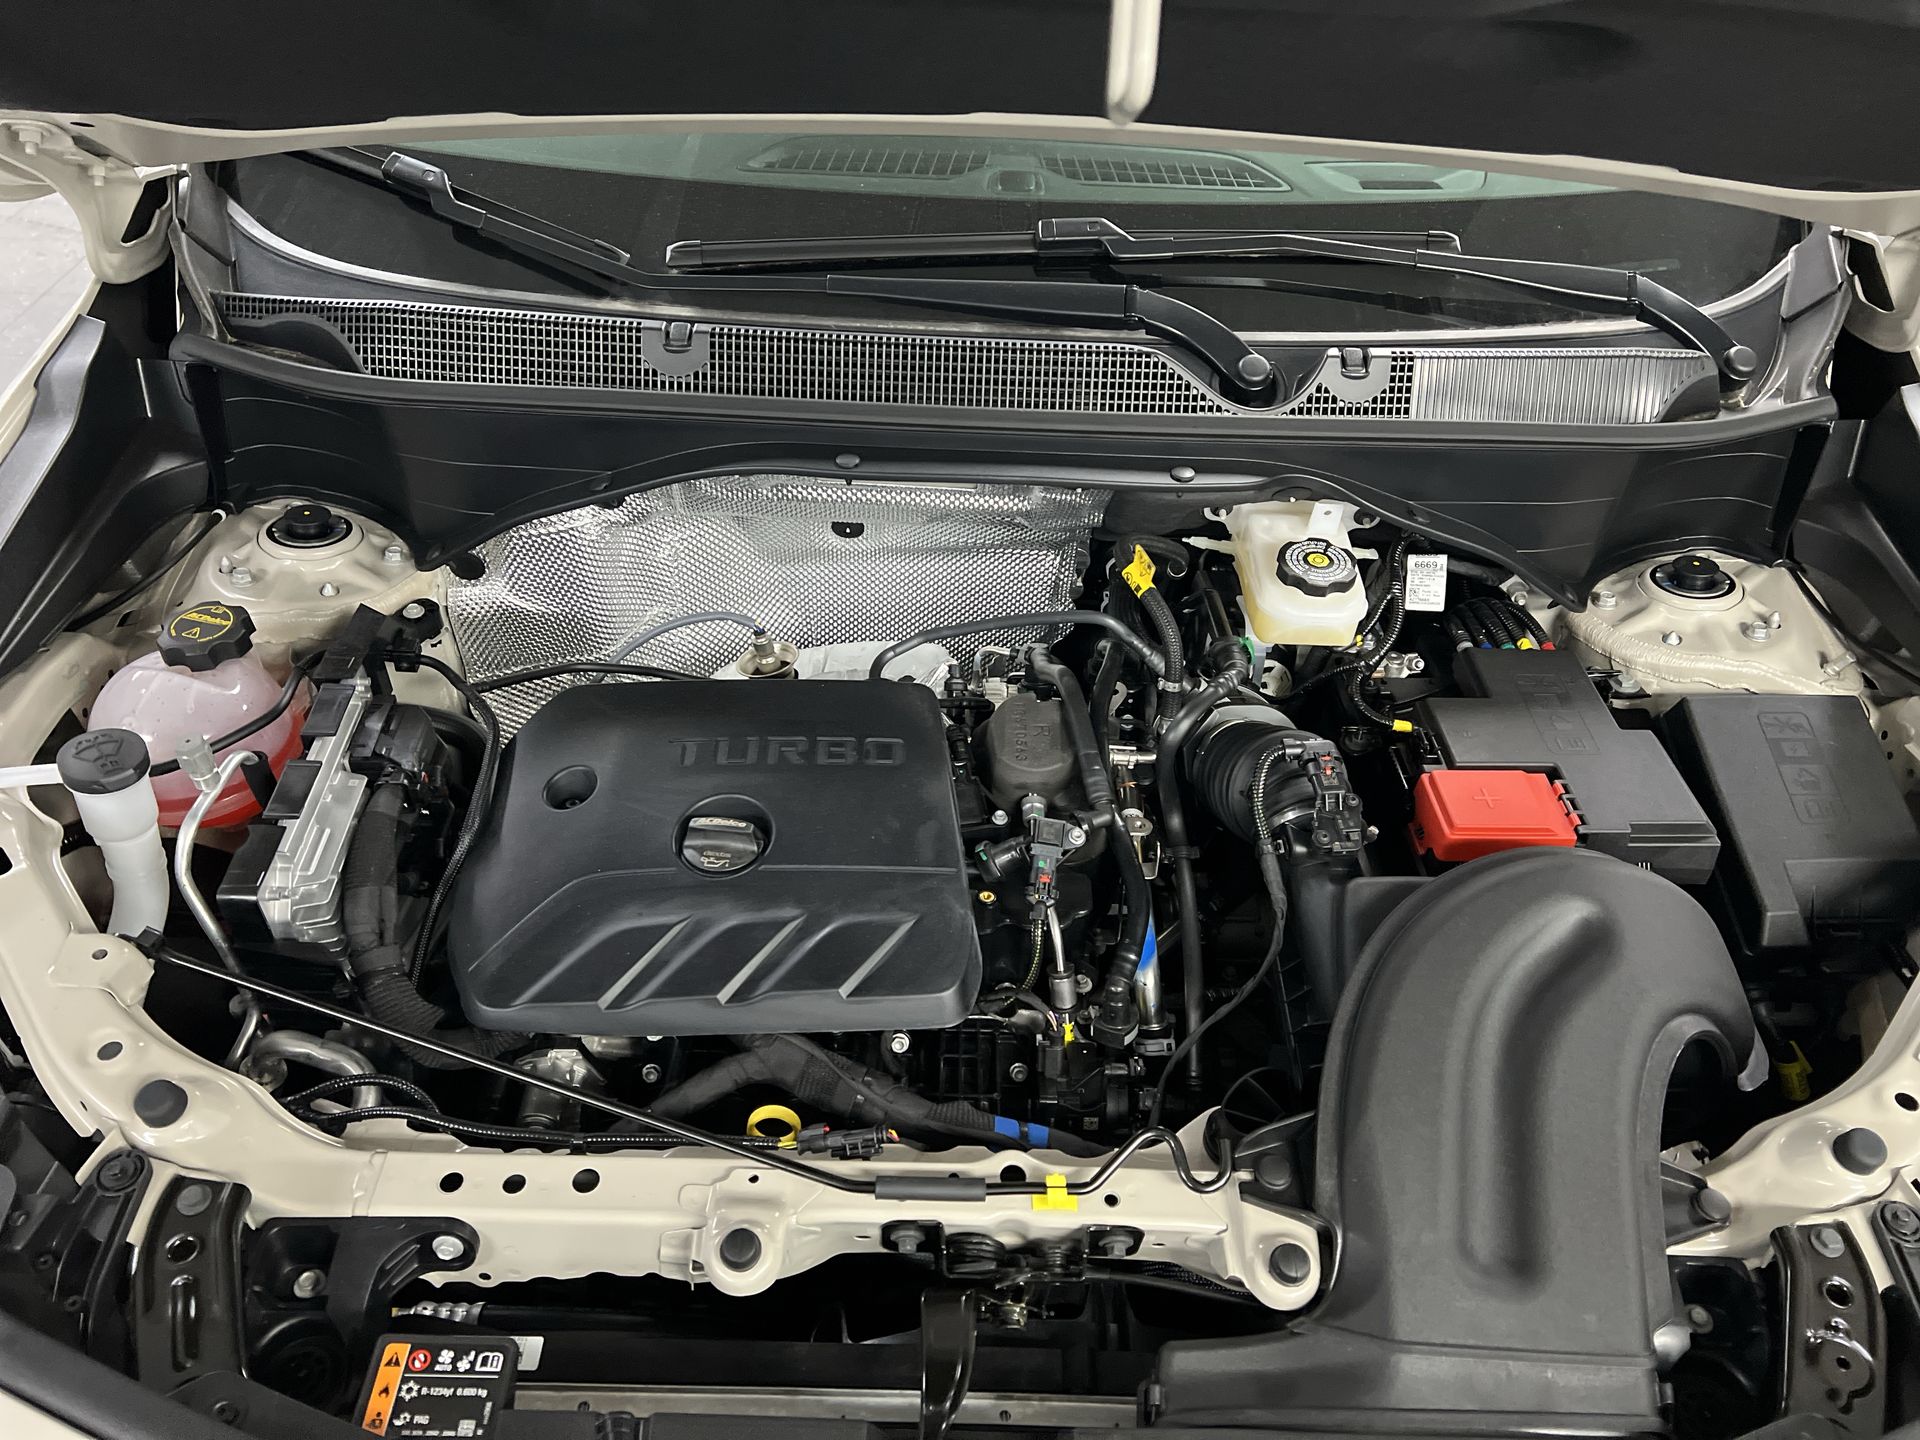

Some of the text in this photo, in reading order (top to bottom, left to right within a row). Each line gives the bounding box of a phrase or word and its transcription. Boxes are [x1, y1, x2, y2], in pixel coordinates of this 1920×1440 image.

[1414, 560, 1438, 569] 6669
[668, 736, 905, 766] TURBO
[695, 817, 747, 827] ACDelco
[434, 1363, 453, 1372] AUTO
[421, 1387, 455, 1398] R-1234yf
[477, 1387, 488, 1399] kg
[413, 1414, 430, 1425] PAG
